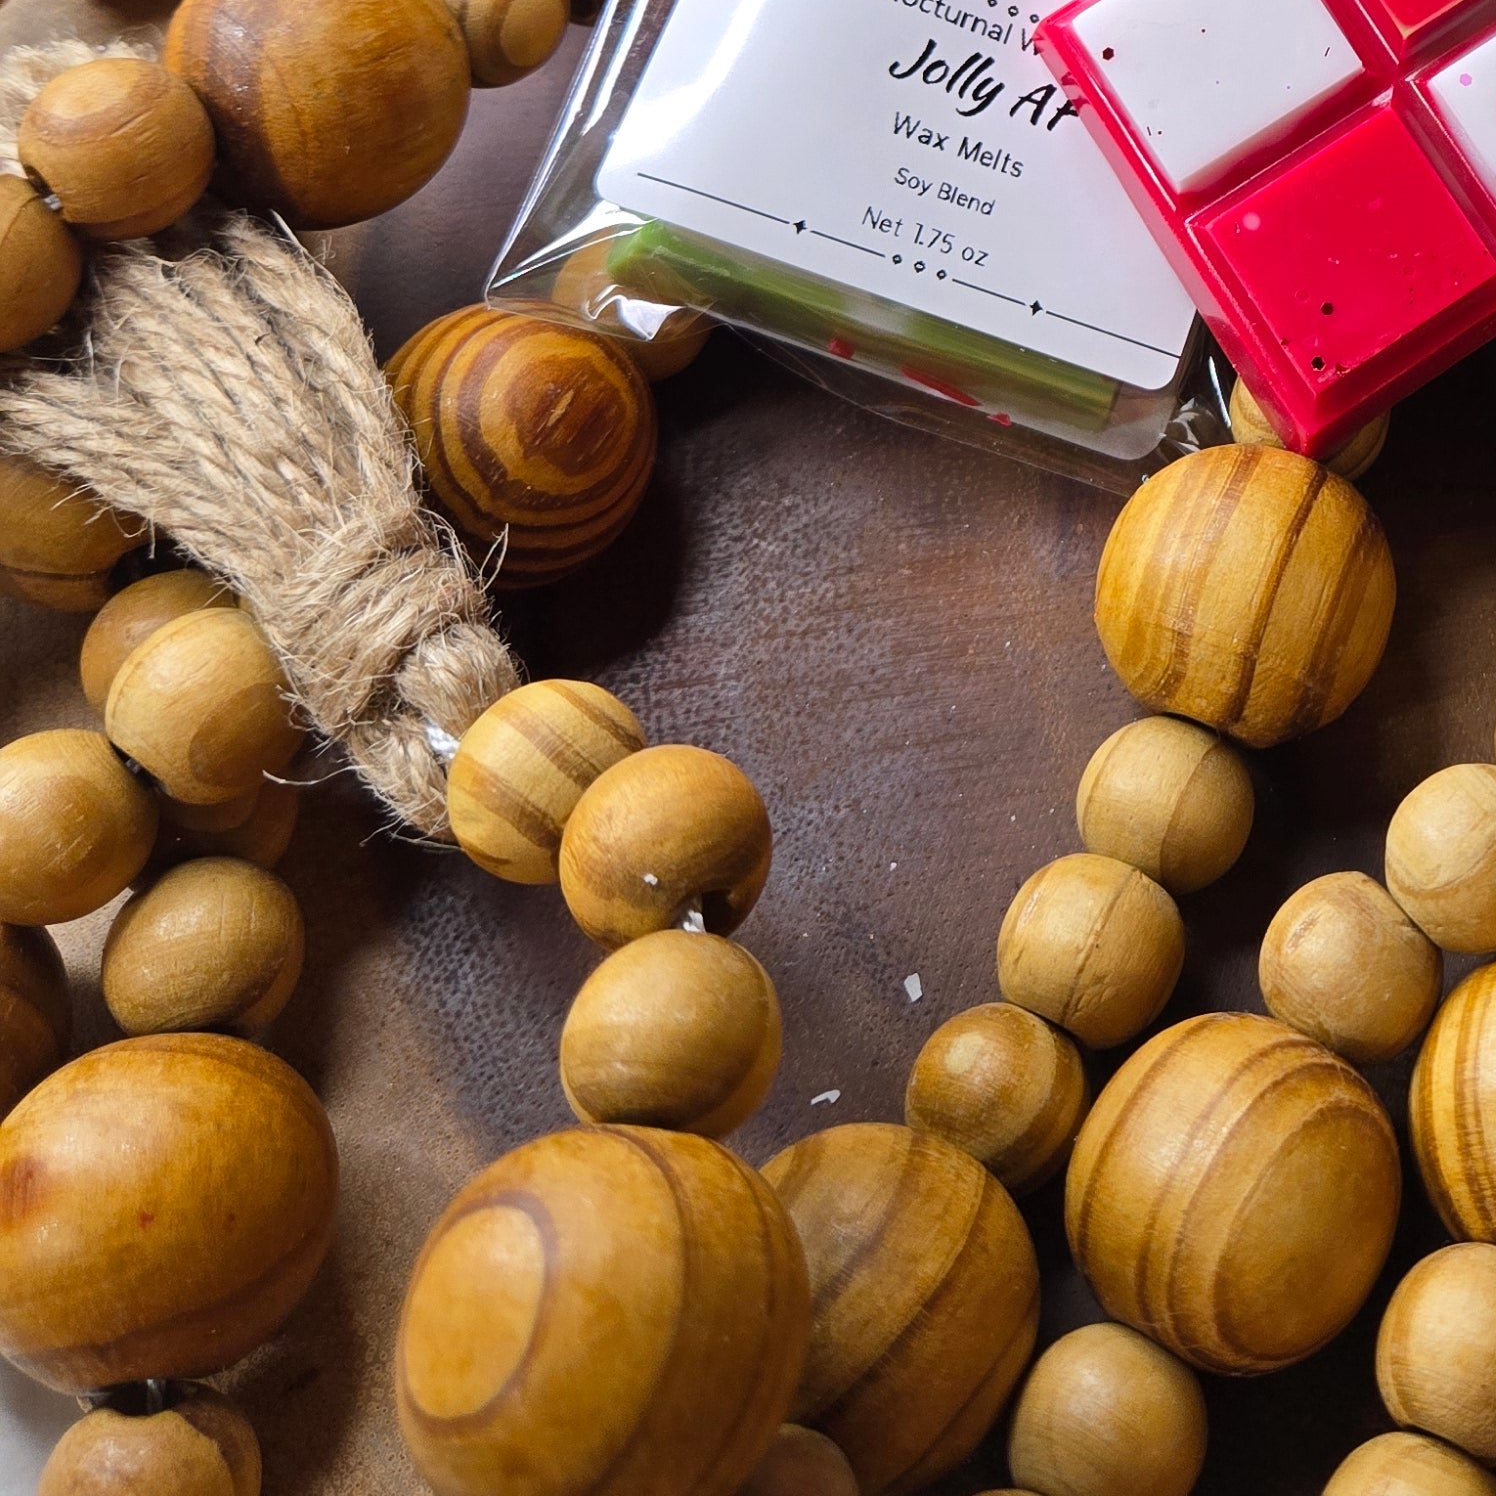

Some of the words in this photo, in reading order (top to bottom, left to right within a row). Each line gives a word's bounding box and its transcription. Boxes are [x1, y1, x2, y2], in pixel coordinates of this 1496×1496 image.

[889, 39, 1005, 117] Jolly
[893, 111, 949, 152] Wax
[957, 137, 1024, 178] Melts
[893, 167, 933, 196] Soy
[937, 182, 996, 216] Blend
[861, 206, 903, 238] Net
[913, 222, 955, 254] 1.75
[961, 246, 990, 267] oz
